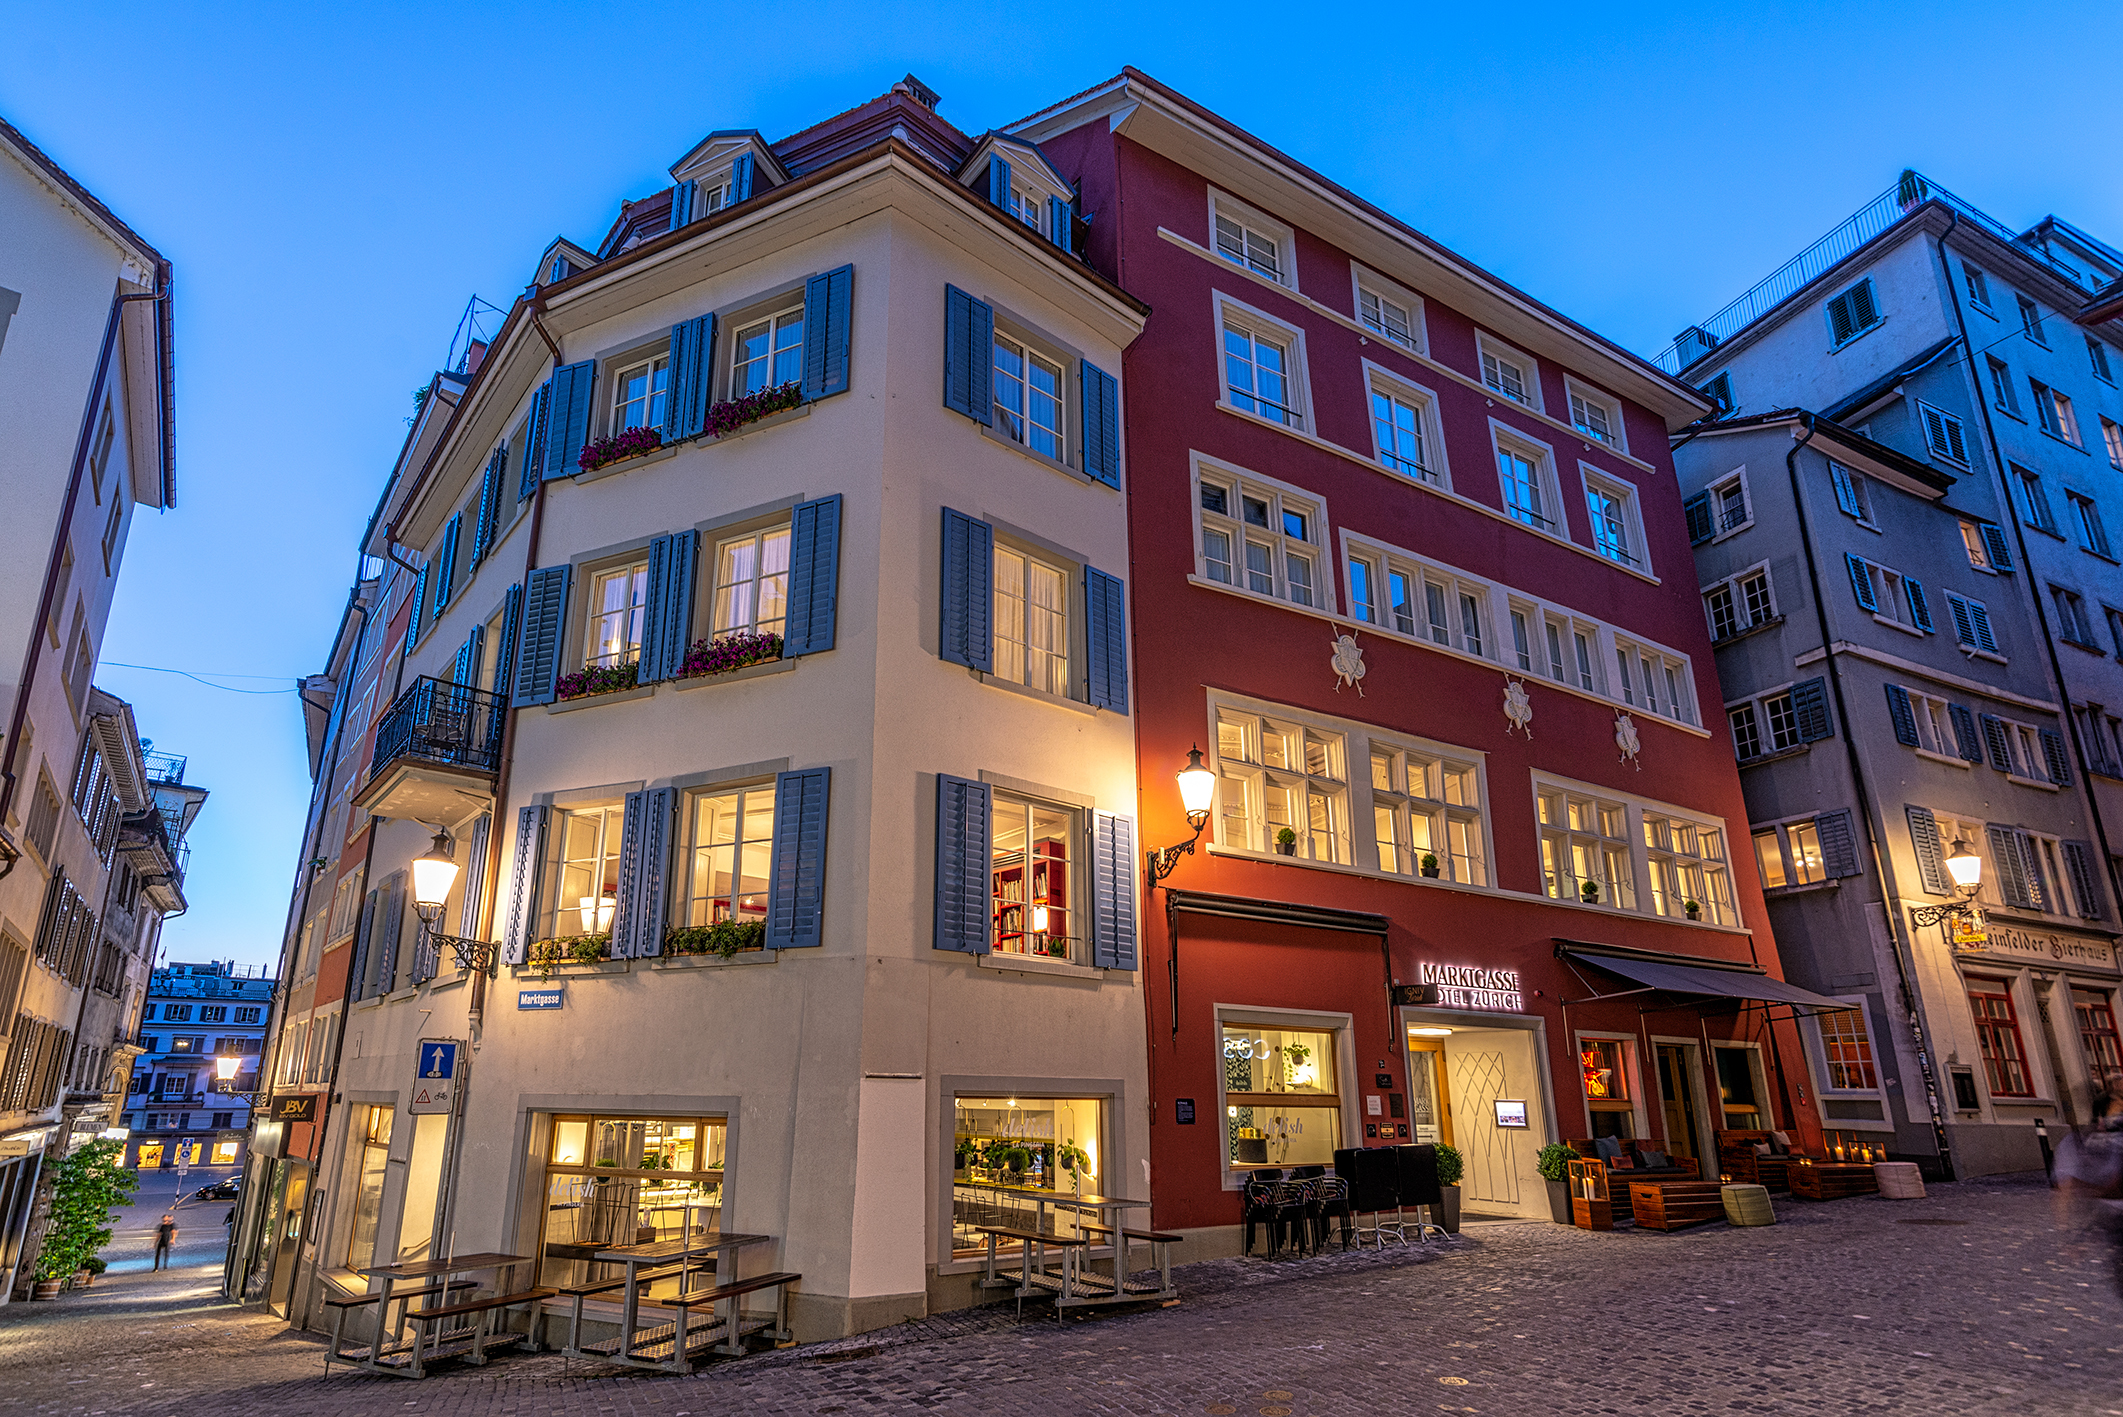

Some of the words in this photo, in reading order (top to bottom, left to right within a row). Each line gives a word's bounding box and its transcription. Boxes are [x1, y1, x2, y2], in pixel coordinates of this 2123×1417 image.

[1965, 927, 2044, 952] einfelder
[2050, 934, 2108, 961] Bierhaus
[1422, 963, 1521, 992] MARKTGASSE
[520, 993, 560, 1007] Marktgasse
[1404, 986, 1425, 995] IGNIV
[1438, 988, 1469, 1006] OTEL
[1473, 988, 1524, 1010] ZÜRICH
[280, 1100, 309, 1114] JBV
[80, 1122, 102, 1131] BLUMEN
[1002, 1117, 1054, 1138] delish
[1263, 1117, 1303, 1134] delish
[549, 1176, 595, 1198] delish
